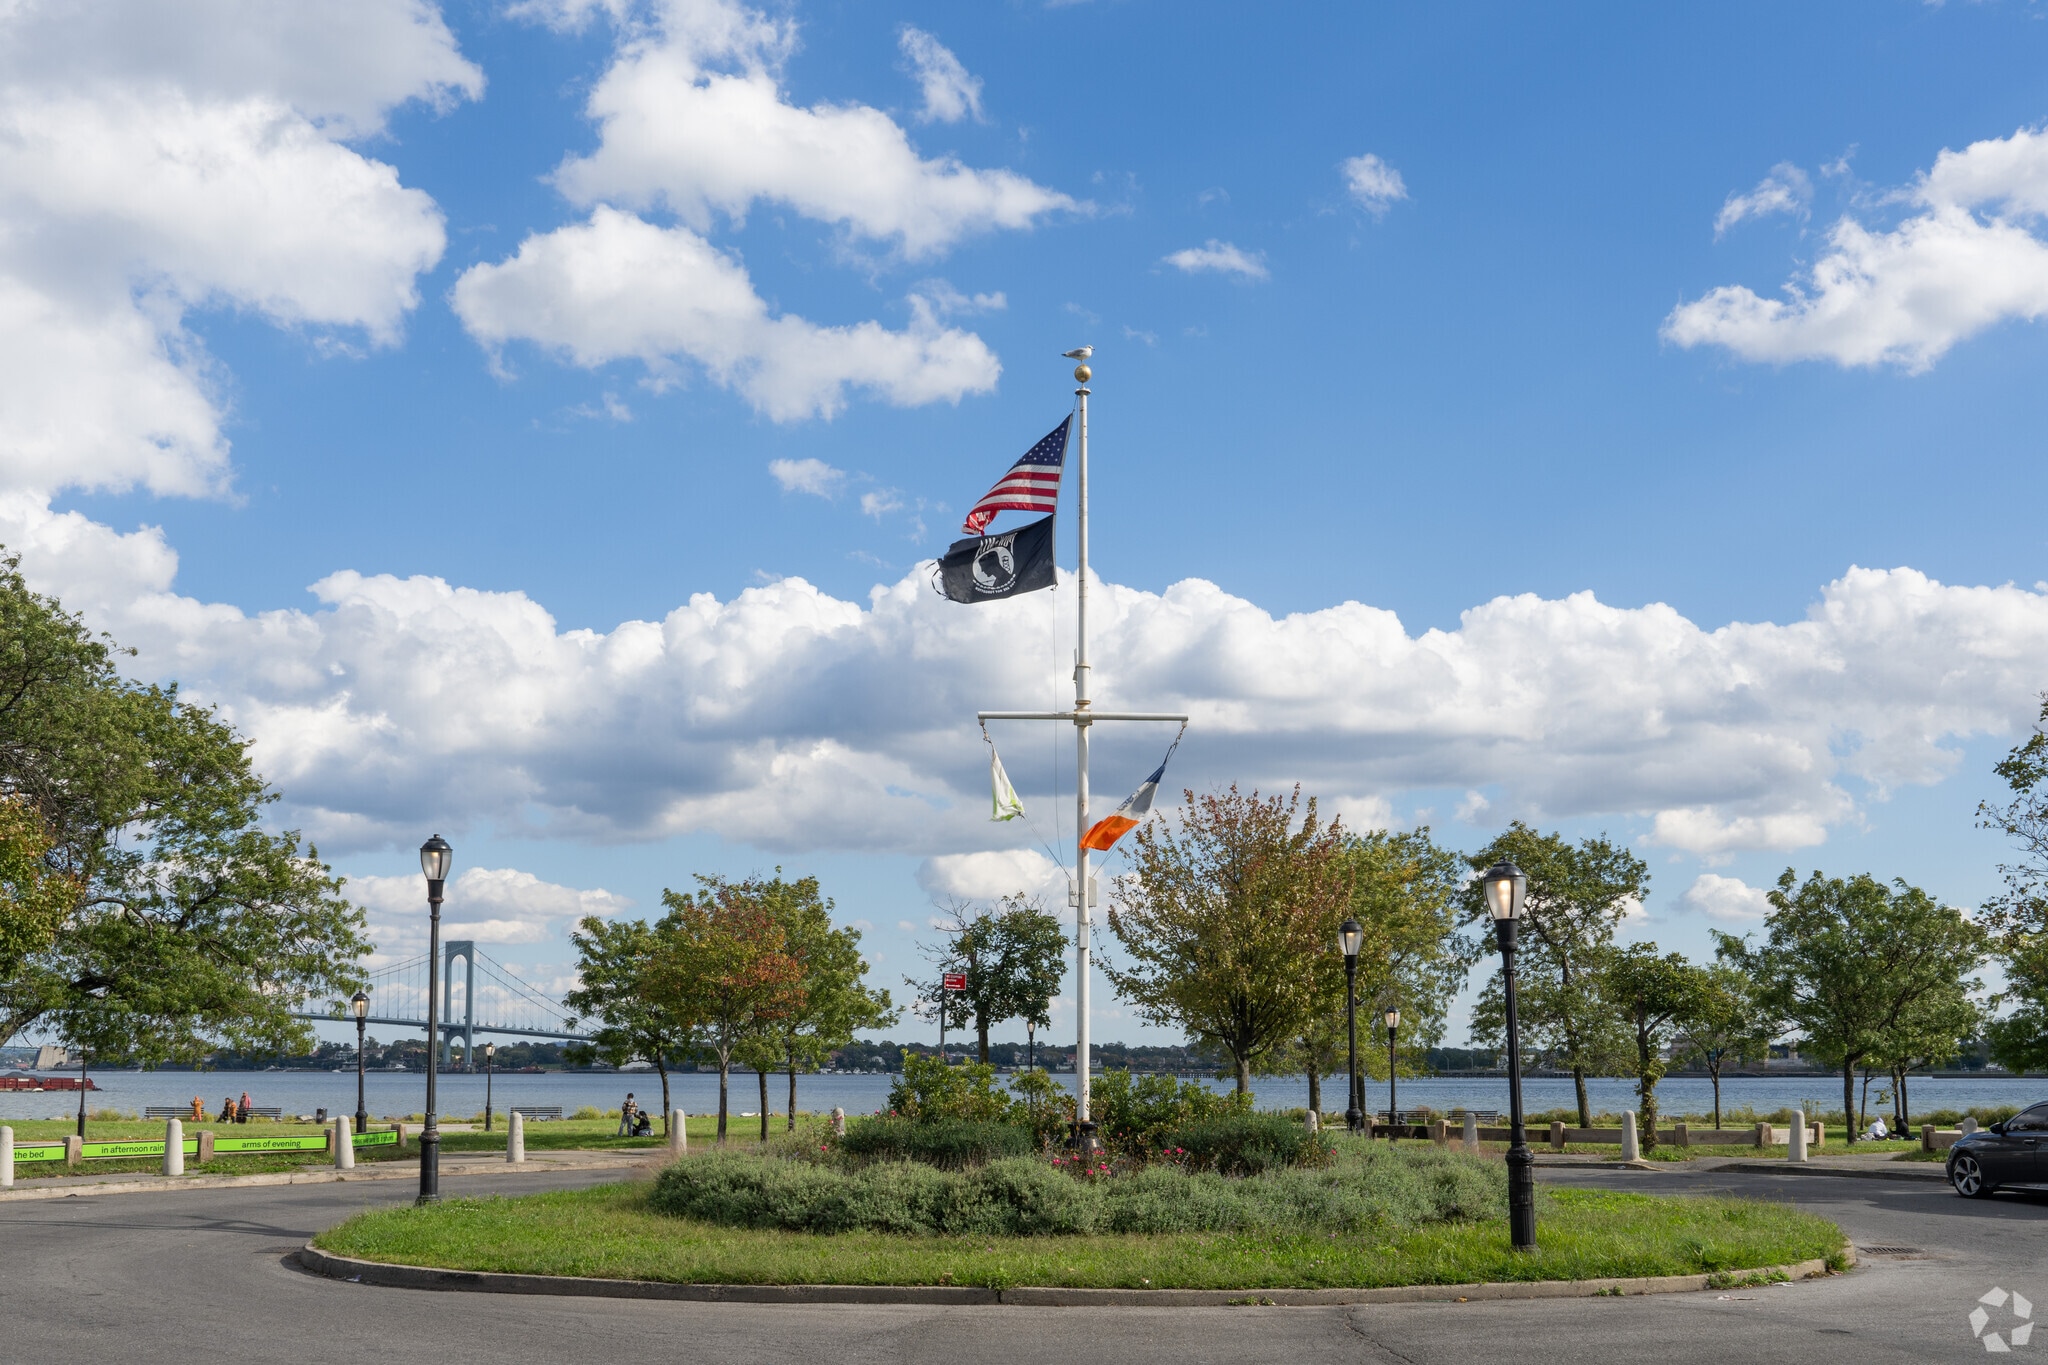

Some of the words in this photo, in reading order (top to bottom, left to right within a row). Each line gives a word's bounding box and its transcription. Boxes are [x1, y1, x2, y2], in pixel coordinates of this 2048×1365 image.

[101, 1146, 109, 1154] in
[110, 1145, 149, 1154] afternoon
[149, 1144, 165, 1152] rain
[262, 1140, 271, 1148] of
[271, 1140, 301, 1149] evening
[14, 1151, 28, 1159] the
[29, 1150, 45, 1158] bed
